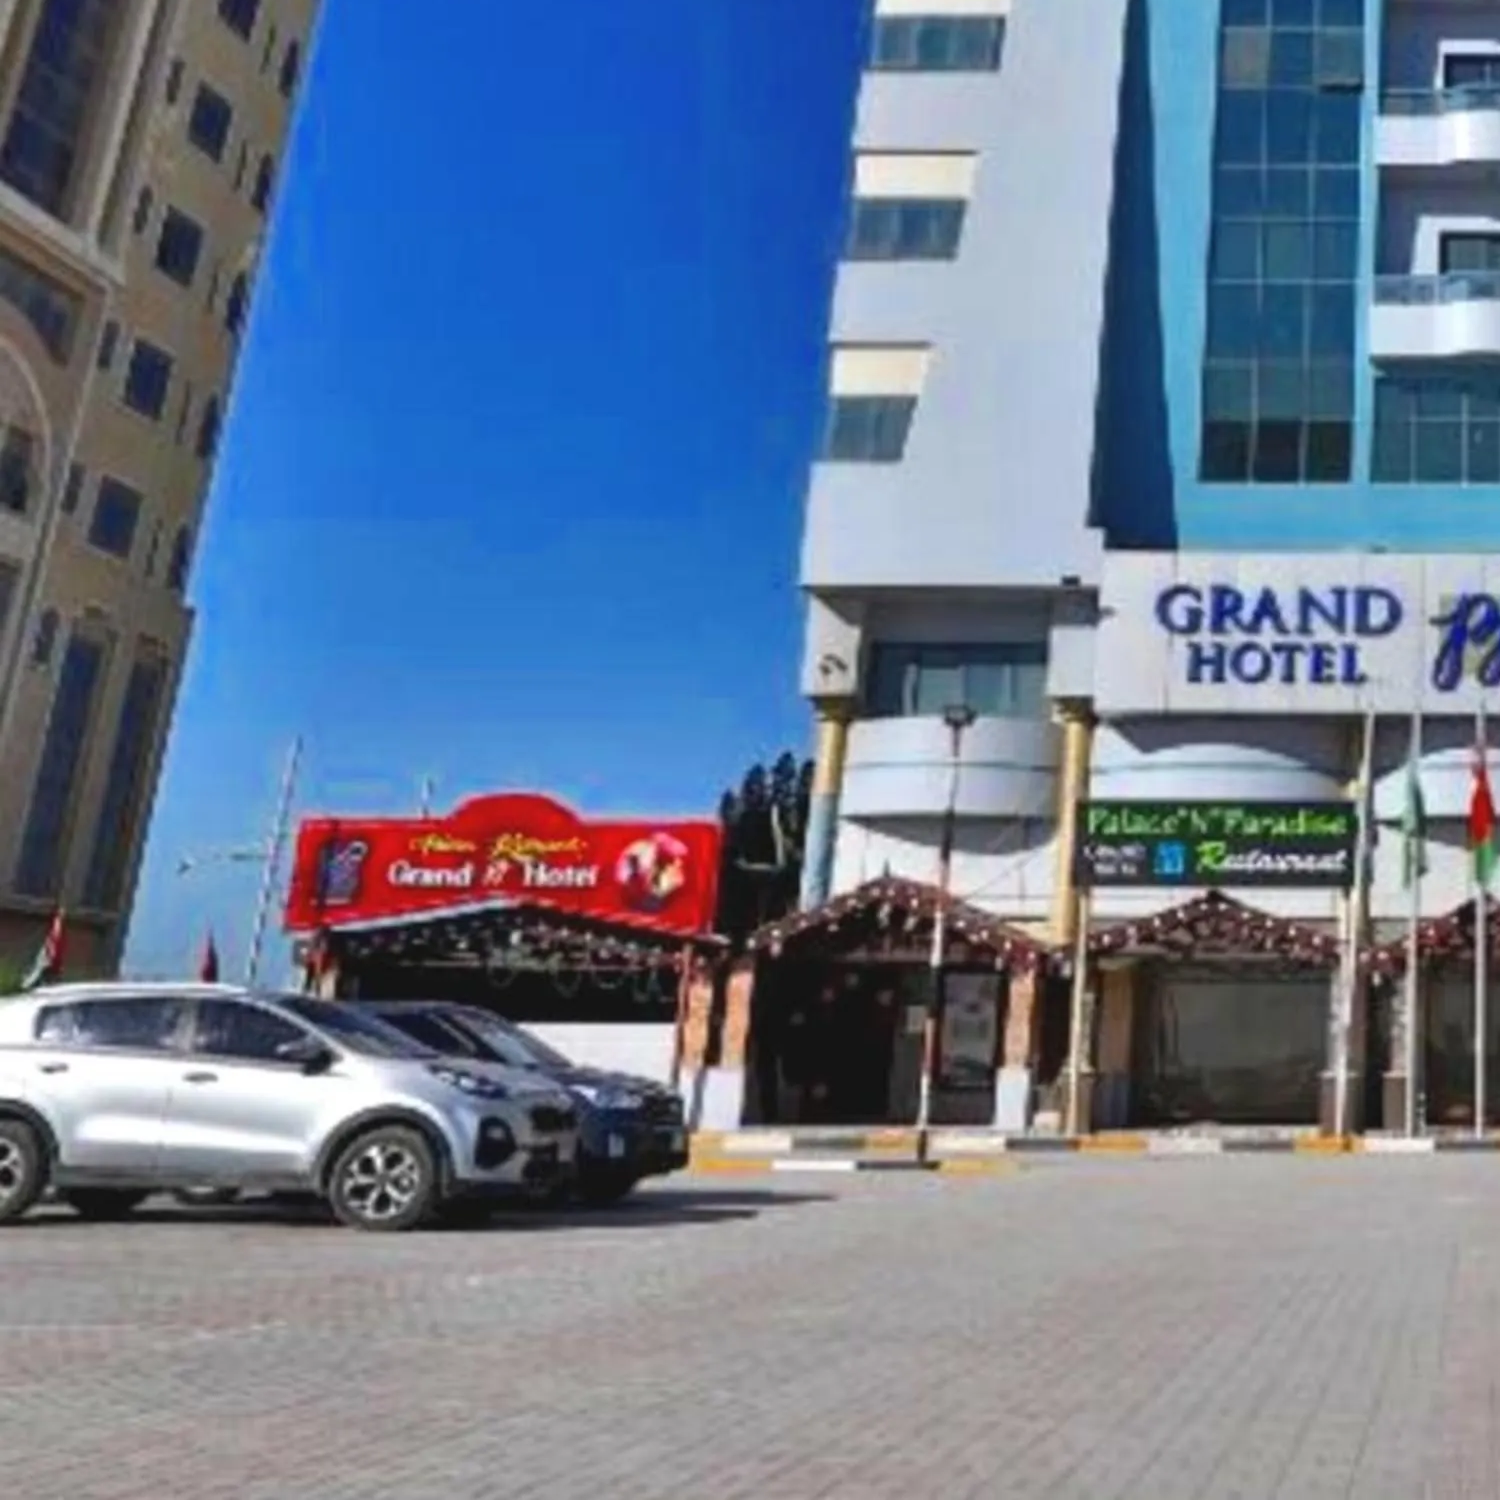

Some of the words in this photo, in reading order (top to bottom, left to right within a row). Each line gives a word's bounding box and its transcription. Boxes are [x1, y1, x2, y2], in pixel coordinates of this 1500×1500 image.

[1155, 584, 1403, 638] GRAND
[1187, 641, 1369, 685] HOTEL
[388, 859, 473, 888] Grand
[519, 859, 598, 888] Hotel
